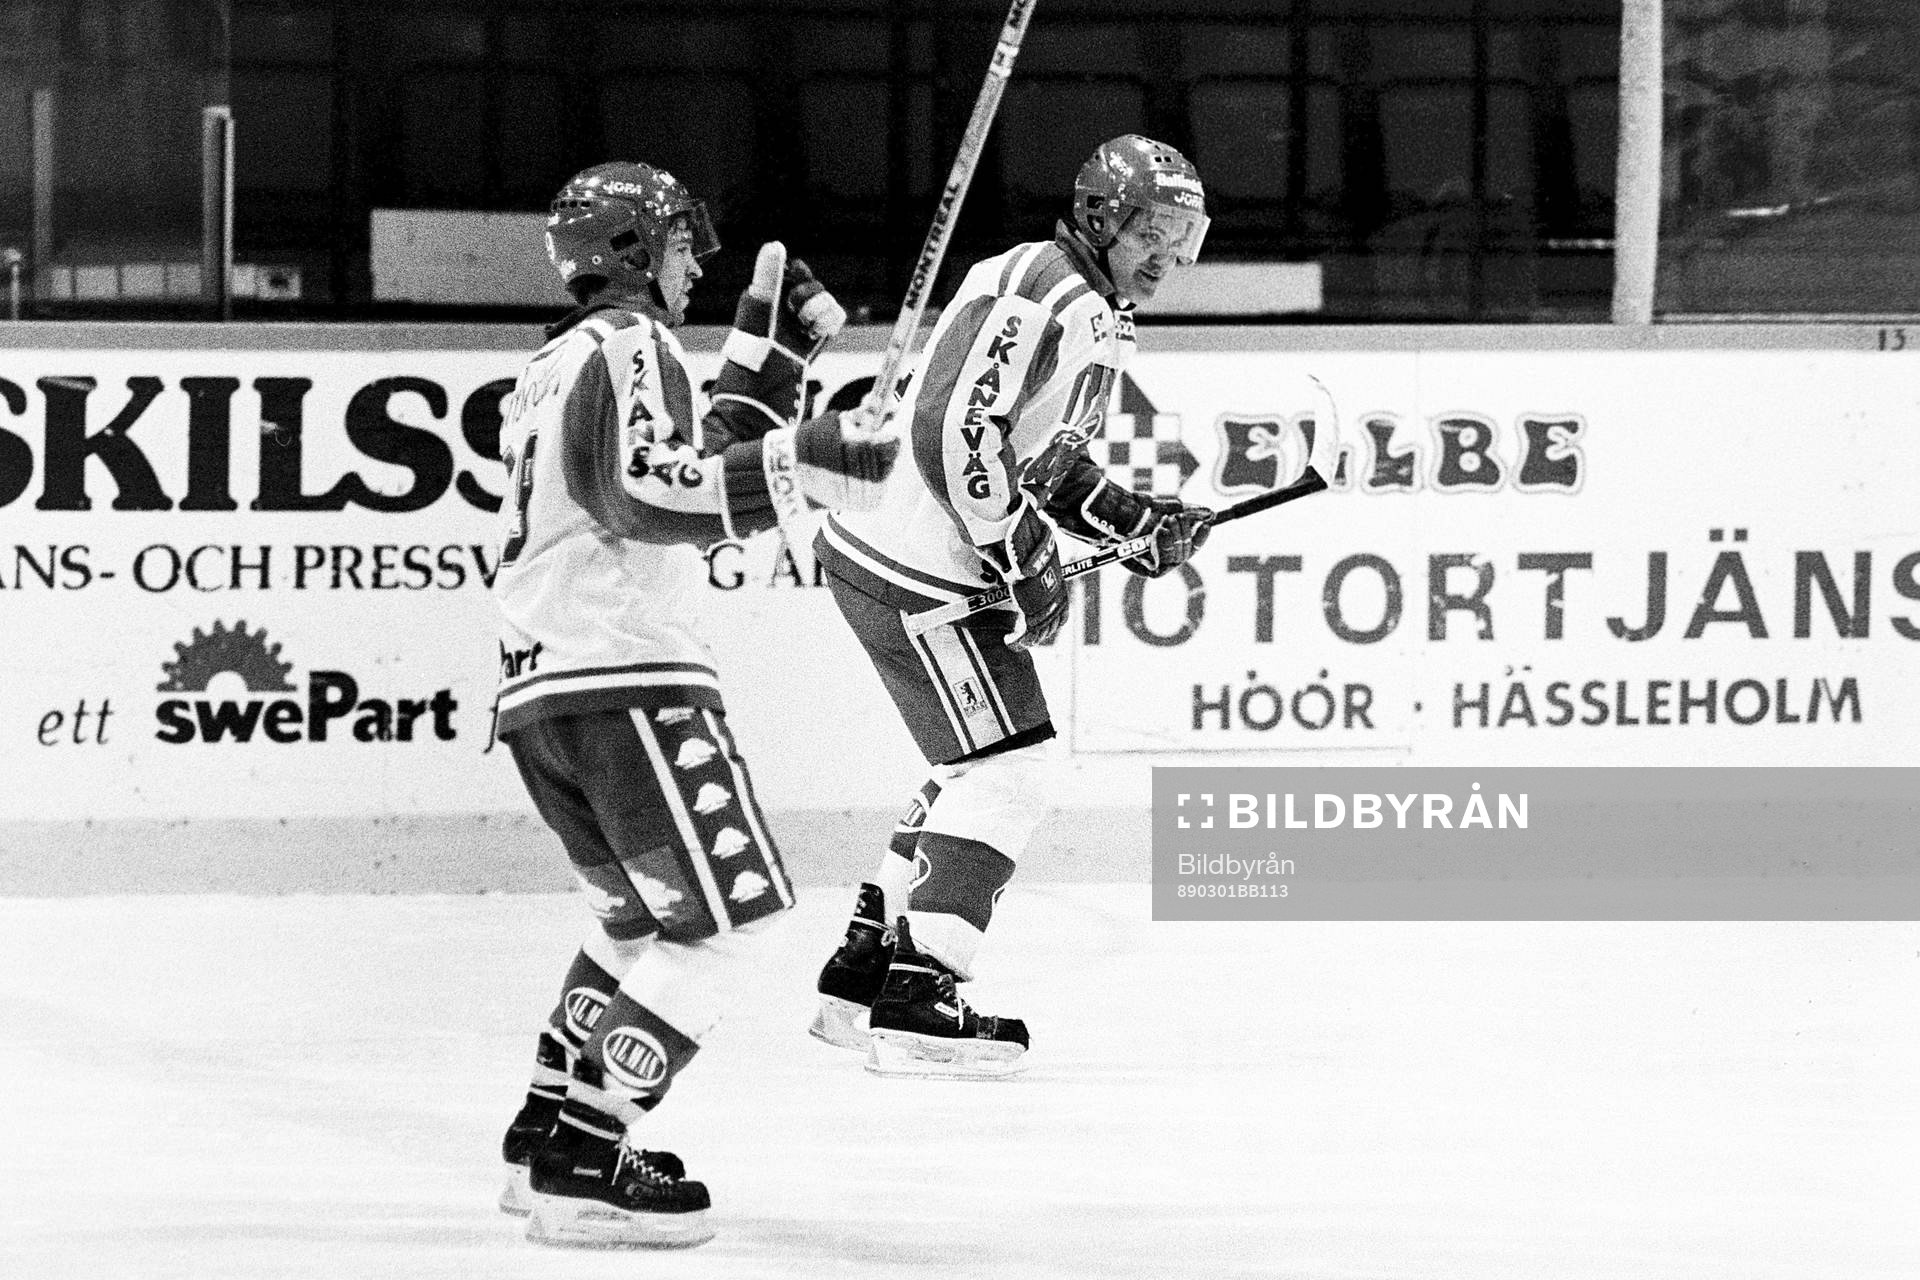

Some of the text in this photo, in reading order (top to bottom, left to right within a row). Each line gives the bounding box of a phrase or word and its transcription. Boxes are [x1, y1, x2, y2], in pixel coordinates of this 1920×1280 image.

[0, 544, 115, 591] NS-
[132, 543, 272, 593] OCH
[37, 698, 114, 747] ett
[155, 670, 459, 745] swePart
[1452, 664, 1863, 728] HÄSSLEHOLM
